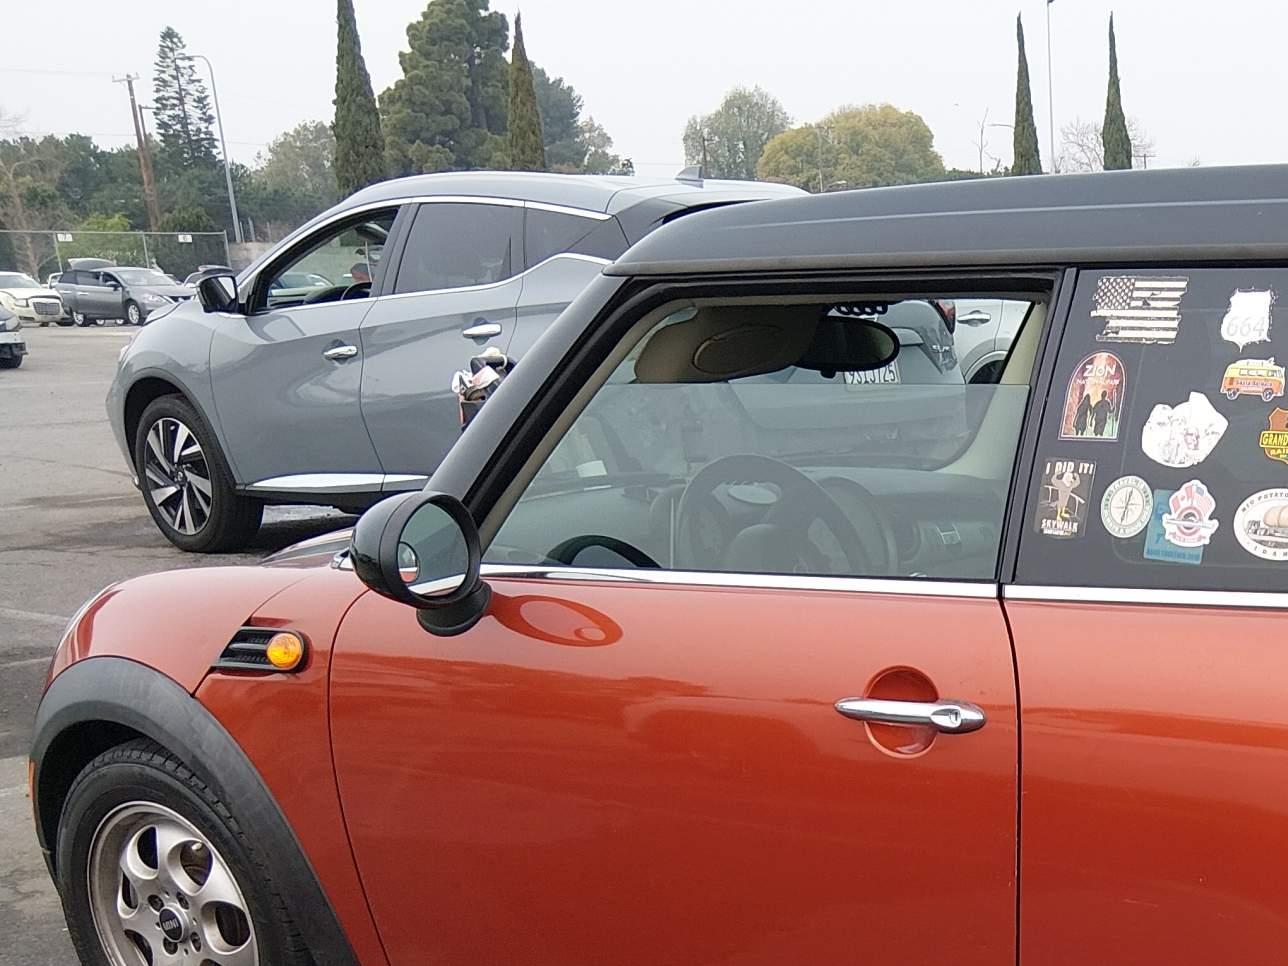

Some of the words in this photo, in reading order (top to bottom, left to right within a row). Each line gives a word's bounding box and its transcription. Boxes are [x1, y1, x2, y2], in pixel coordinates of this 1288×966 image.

[1083, 364, 1117, 377] ZION
[1262, 433, 1288, 447] GRAND
[1054, 461, 1075, 474] DID
[1041, 518, 1079, 533] SKYWALK
